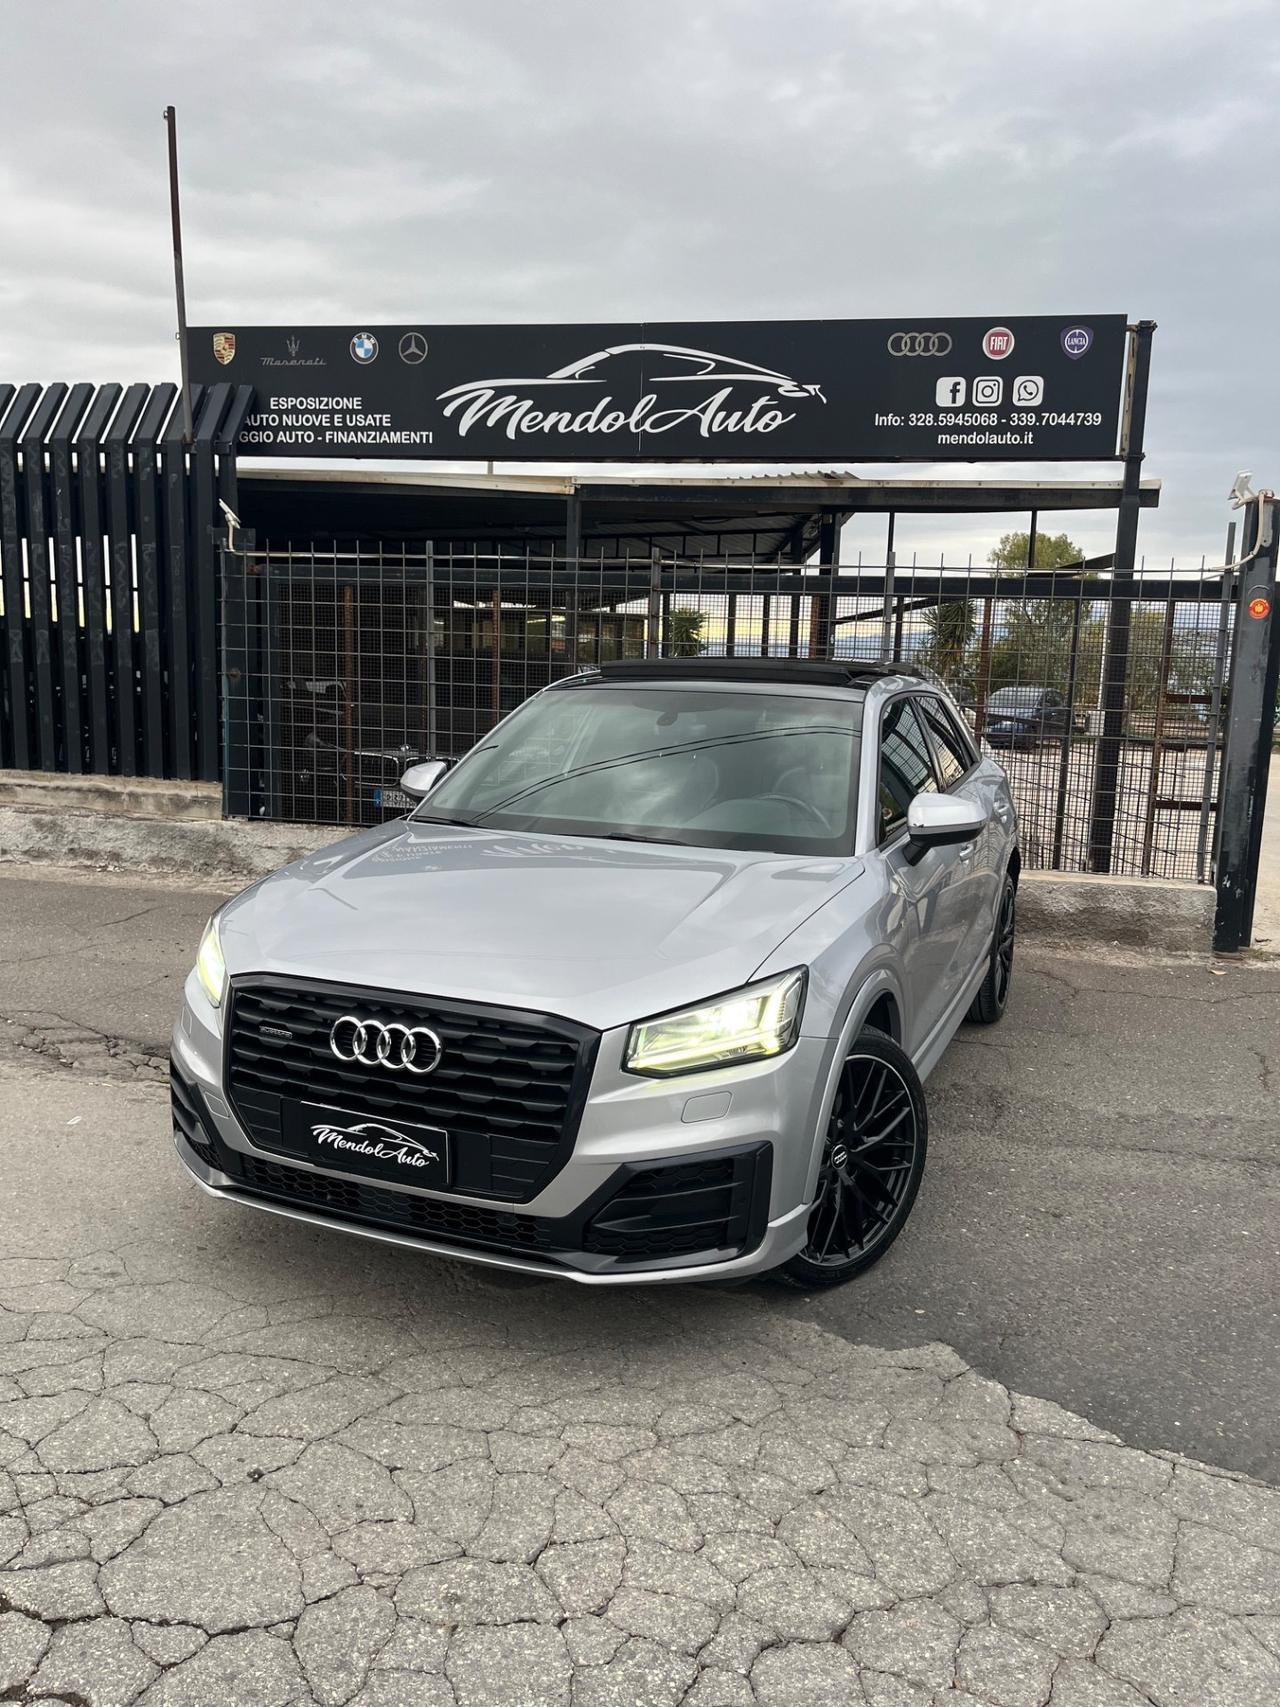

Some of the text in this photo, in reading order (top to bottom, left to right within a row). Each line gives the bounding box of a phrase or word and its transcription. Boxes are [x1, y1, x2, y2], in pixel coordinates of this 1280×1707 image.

[990, 336, 1009, 351] FIAT
[1067, 337, 1087, 346] LANCIA
[270, 397, 362, 410] ESPOSIZIONE
[282, 414, 331, 427] NUOVE
[333, 414, 343, 427] E
[346, 414, 391, 427] USATE
[875, 412, 904, 427] Info:
[908, 412, 998, 427] 328.5945068
[1009, 412, 1102, 427] 339.7044739
[239, 431, 274, 444] GGIO
[276, 431, 315, 444] AUTO
[325, 431, 433, 444] FINANZIAMENTI
[937, 431, 1034, 445] mendolauto.it
